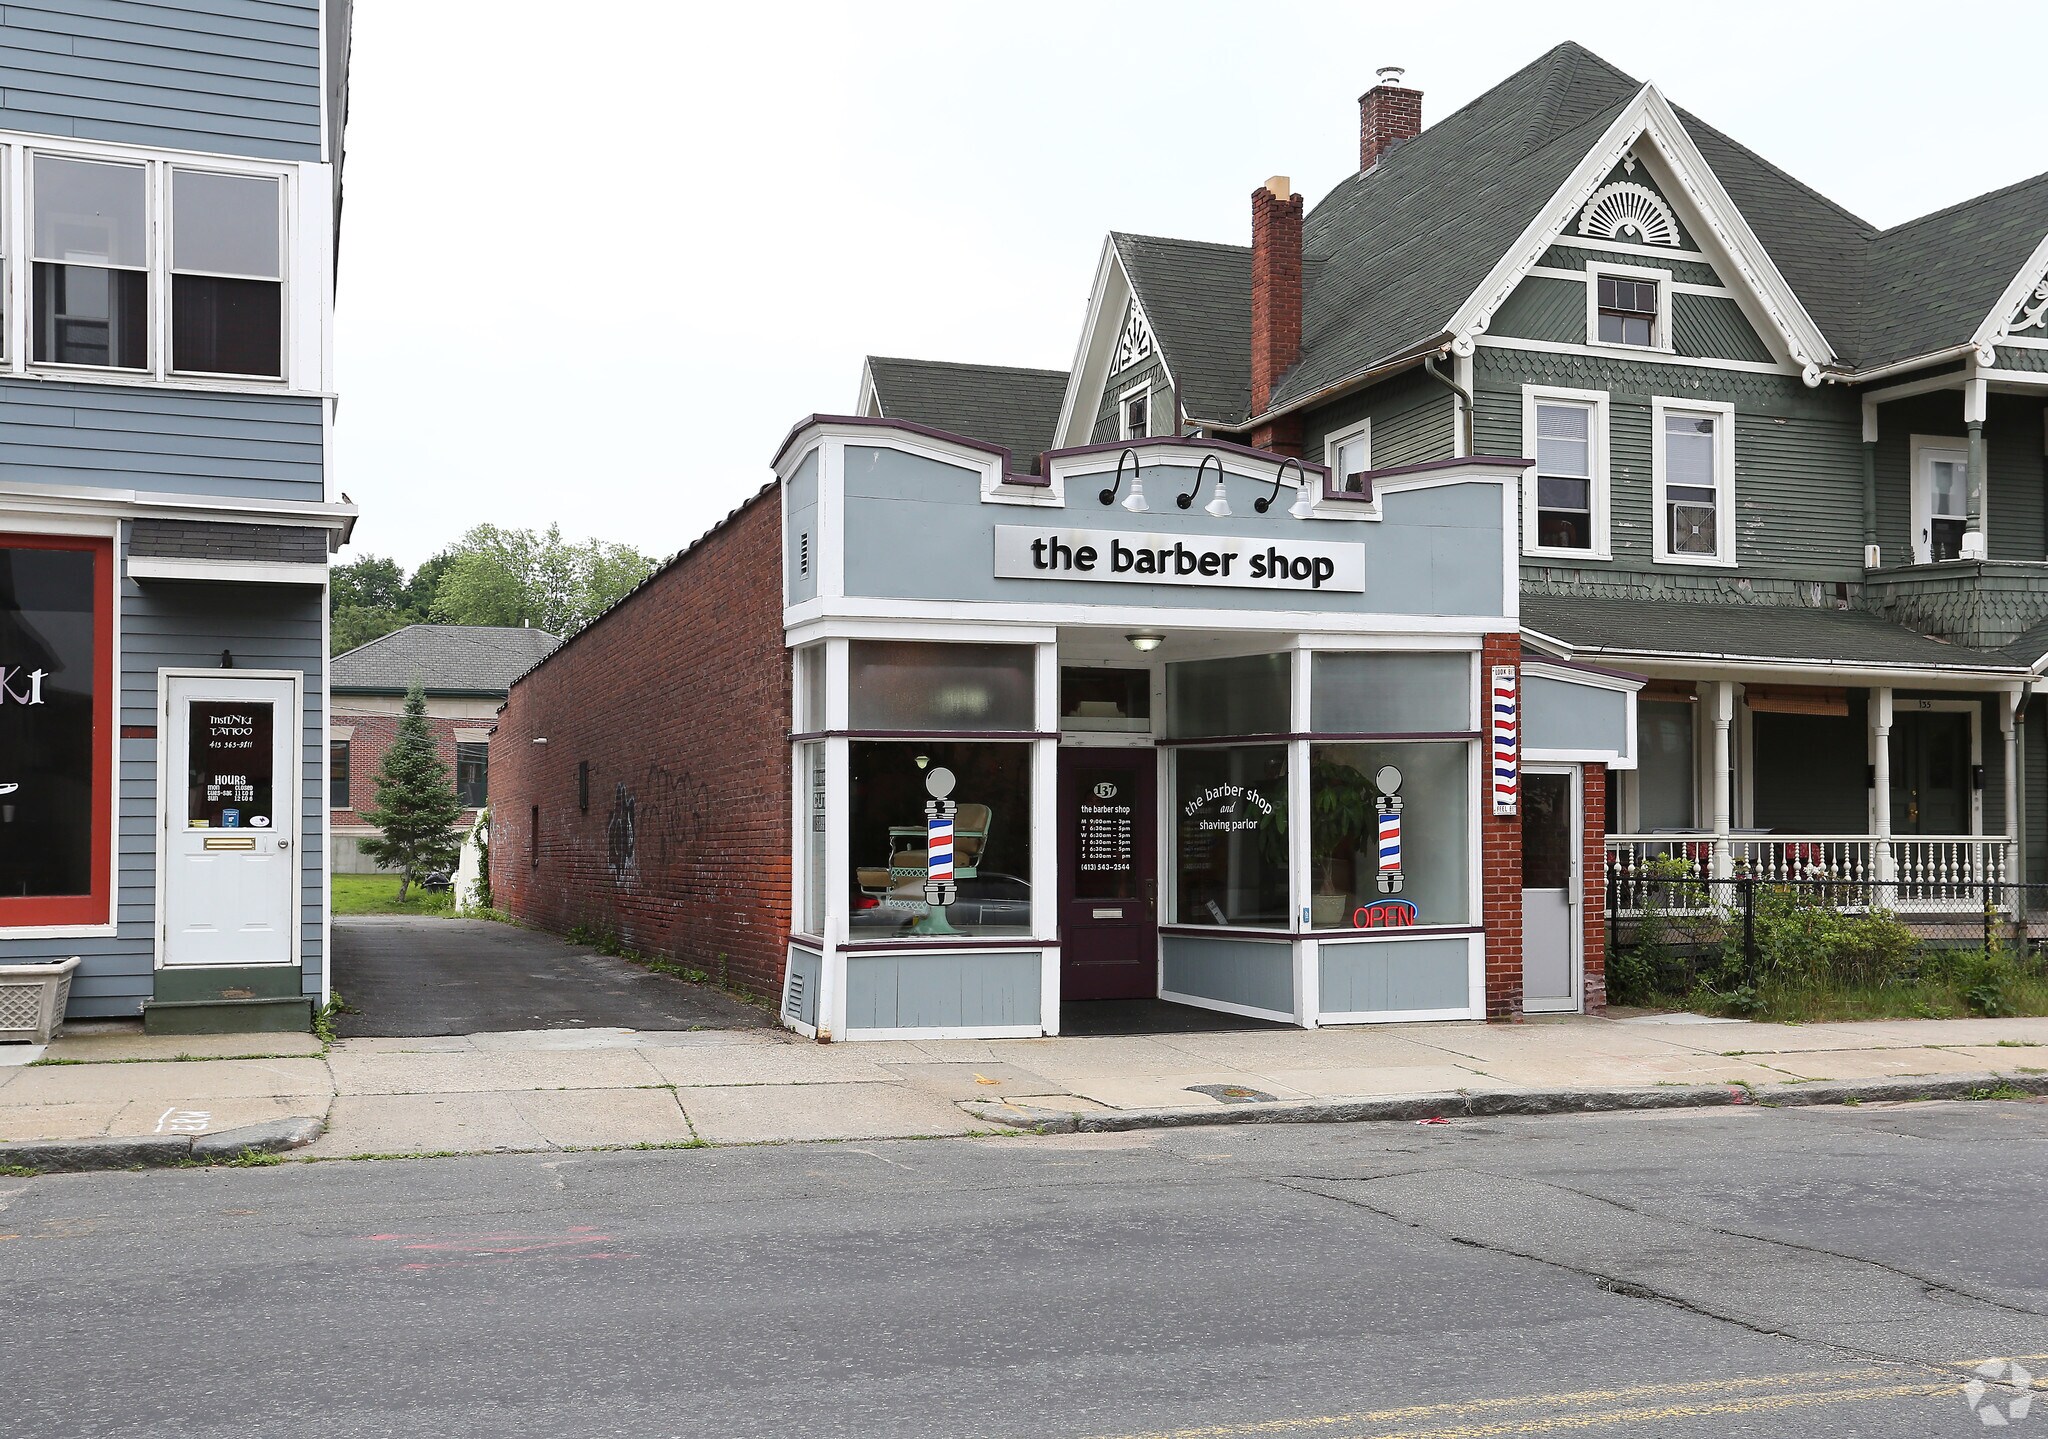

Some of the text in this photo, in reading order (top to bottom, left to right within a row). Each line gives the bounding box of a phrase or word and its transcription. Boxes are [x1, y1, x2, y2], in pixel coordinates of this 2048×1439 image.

[1031, 535, 1334, 588] the barber shop
[1919, 699, 1931, 708] 135
[209, 726, 253, 736] TATTOO
[214, 774, 246, 785] HOURS
[1096, 784, 1115, 796] 137
[1185, 782, 1272, 816] the barber shop
[1081, 805, 1130, 815] the barber shop
[1220, 801, 1236, 813] and
[1200, 818, 1258, 832] shaving parlor
[1354, 905, 1414, 928] OPEN
